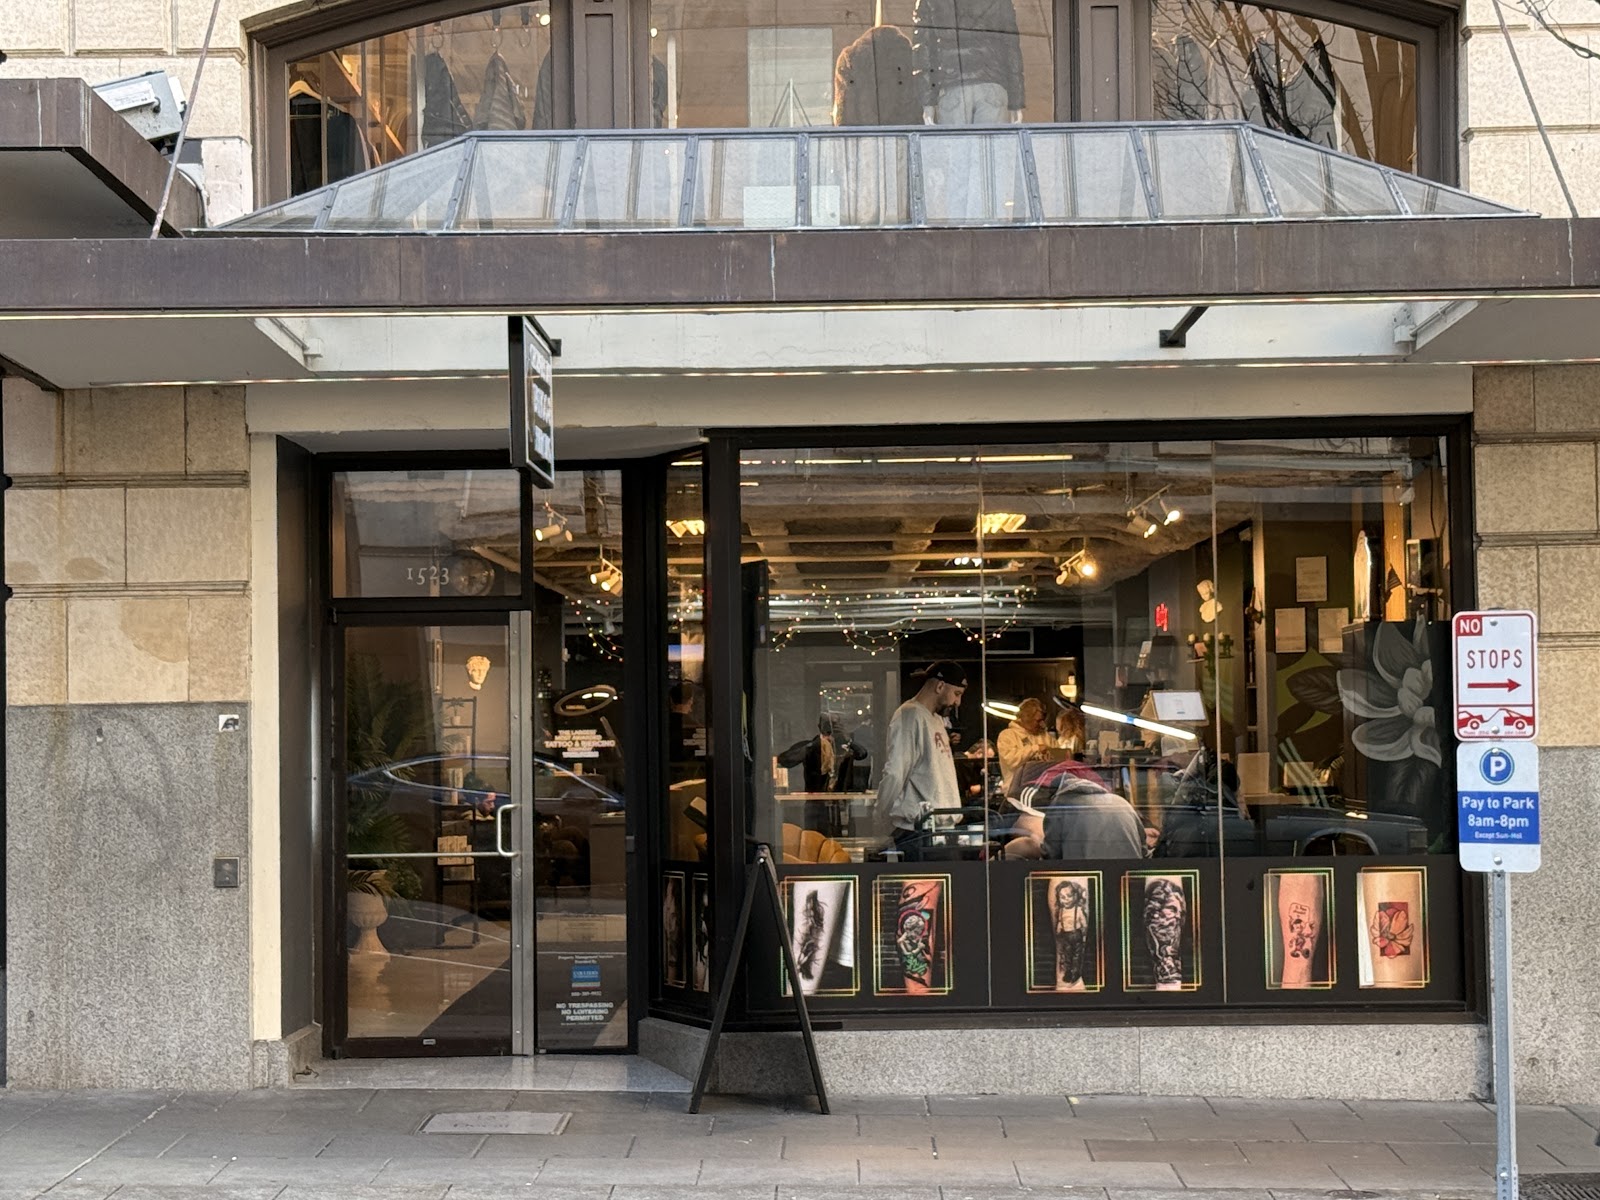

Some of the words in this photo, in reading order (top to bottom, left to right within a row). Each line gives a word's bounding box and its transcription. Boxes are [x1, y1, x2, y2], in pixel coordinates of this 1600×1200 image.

[407, 565, 450, 585] 1523
[1460, 619, 1480, 633] NO
[1466, 649, 1523, 669] STOPS
[544, 740, 573, 748] TATTOO
[1490, 756, 1507, 778] P
[1462, 796, 1485, 811] Pay
[1487, 797, 1500, 809] to
[1503, 796, 1535, 809] Park
[1468, 813, 1529, 830] 8am-8pm
